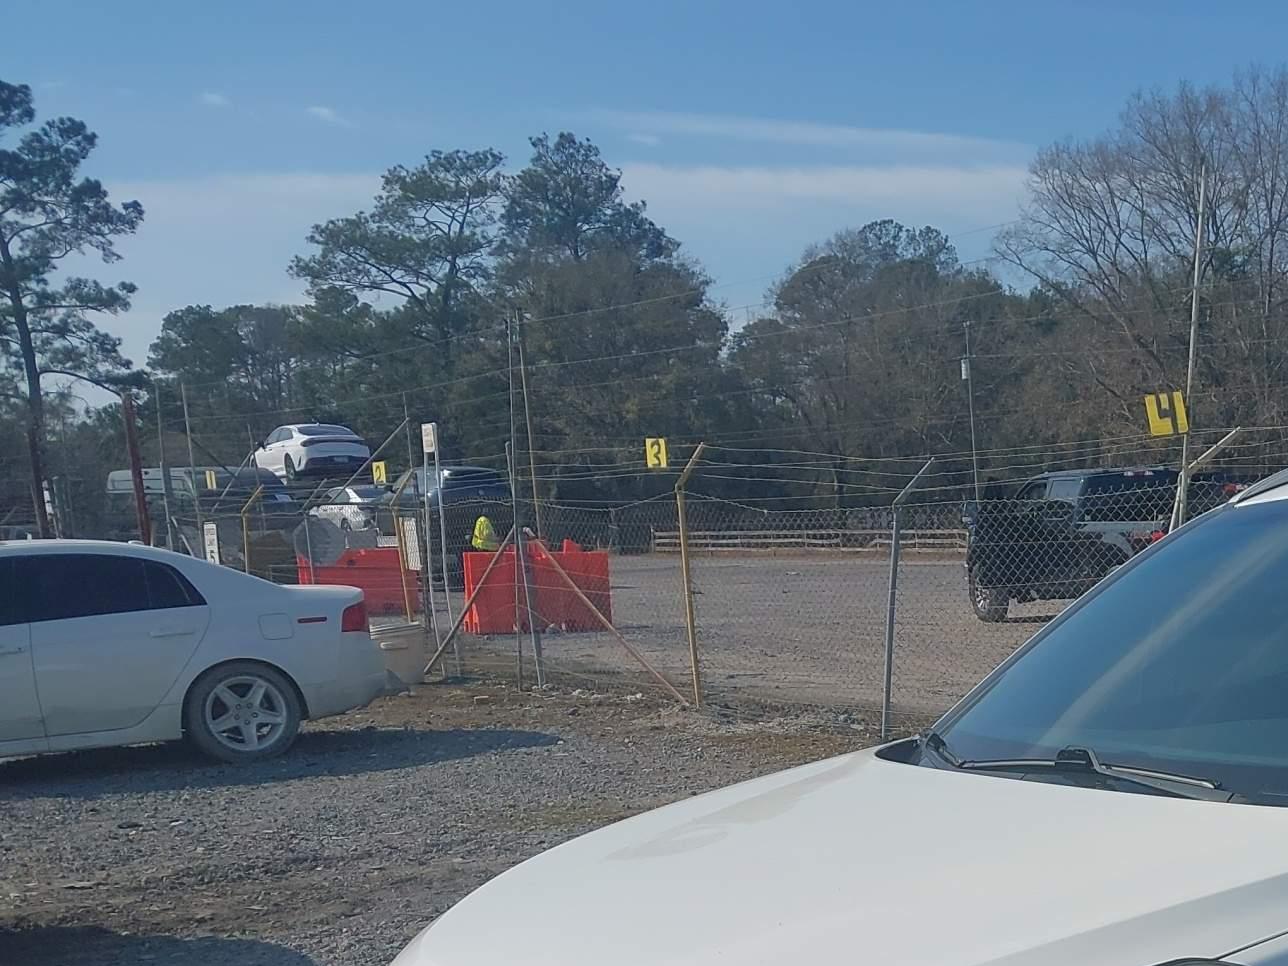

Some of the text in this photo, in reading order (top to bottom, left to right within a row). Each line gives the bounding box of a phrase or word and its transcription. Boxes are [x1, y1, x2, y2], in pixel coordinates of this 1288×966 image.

[1153, 391, 1180, 434] 4
[650, 439, 662, 467] 3
[375, 464, 385, 484] 2
